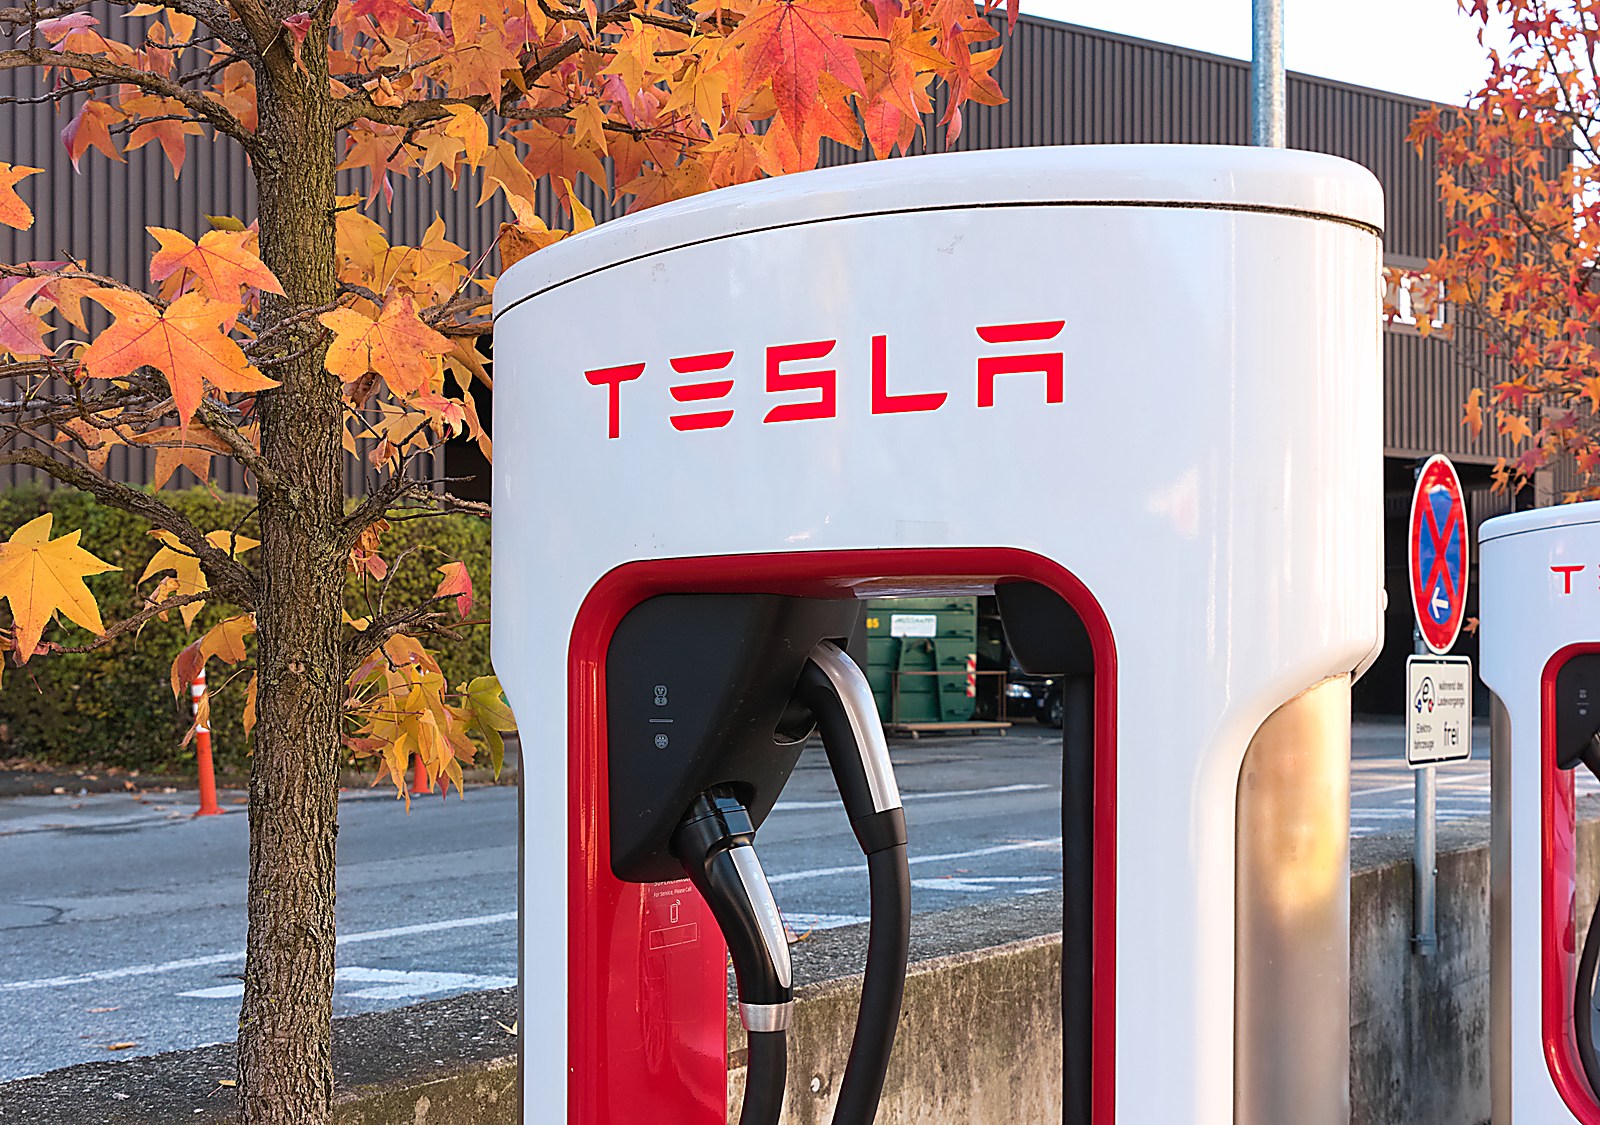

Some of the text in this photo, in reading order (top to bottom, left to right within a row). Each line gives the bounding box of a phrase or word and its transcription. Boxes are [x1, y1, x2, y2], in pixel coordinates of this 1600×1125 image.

[584, 320, 1066, 438] TESLA
[1550, 565, 1600, 594] T
[1444, 721, 1459, 745] frei
